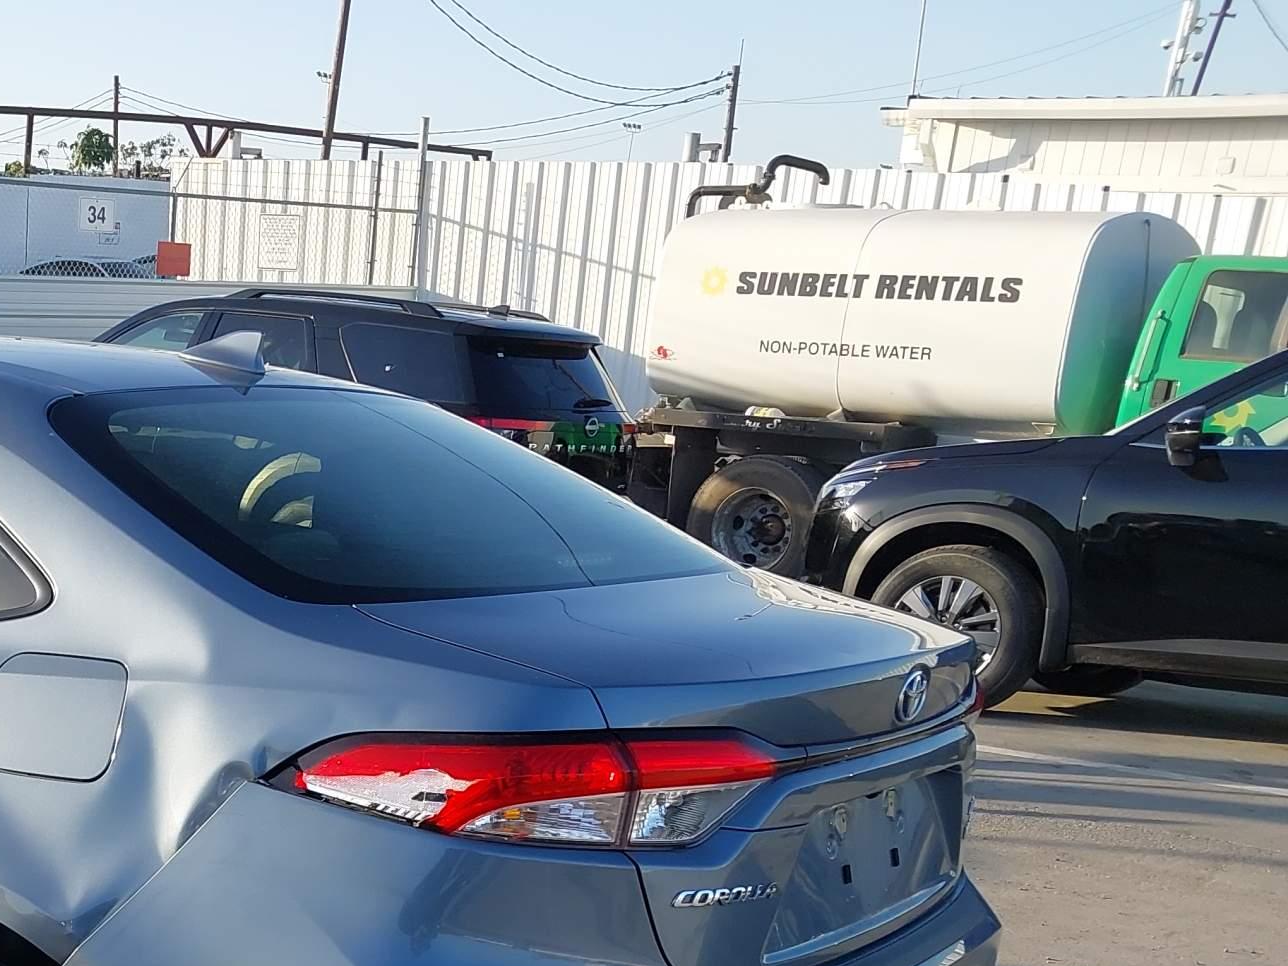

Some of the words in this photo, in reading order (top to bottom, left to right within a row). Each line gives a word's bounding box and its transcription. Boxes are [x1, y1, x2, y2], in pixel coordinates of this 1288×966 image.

[88, 205, 107, 225] 34
[735, 271, 870, 299] SUNBELT
[874, 274, 1024, 304] RENTALS
[759, 339, 871, 358] NON-POTABLE
[875, 344, 932, 361] WATER
[528, 443, 633, 453] PATHFINDER
[671, 881, 777, 908] COROLLA
